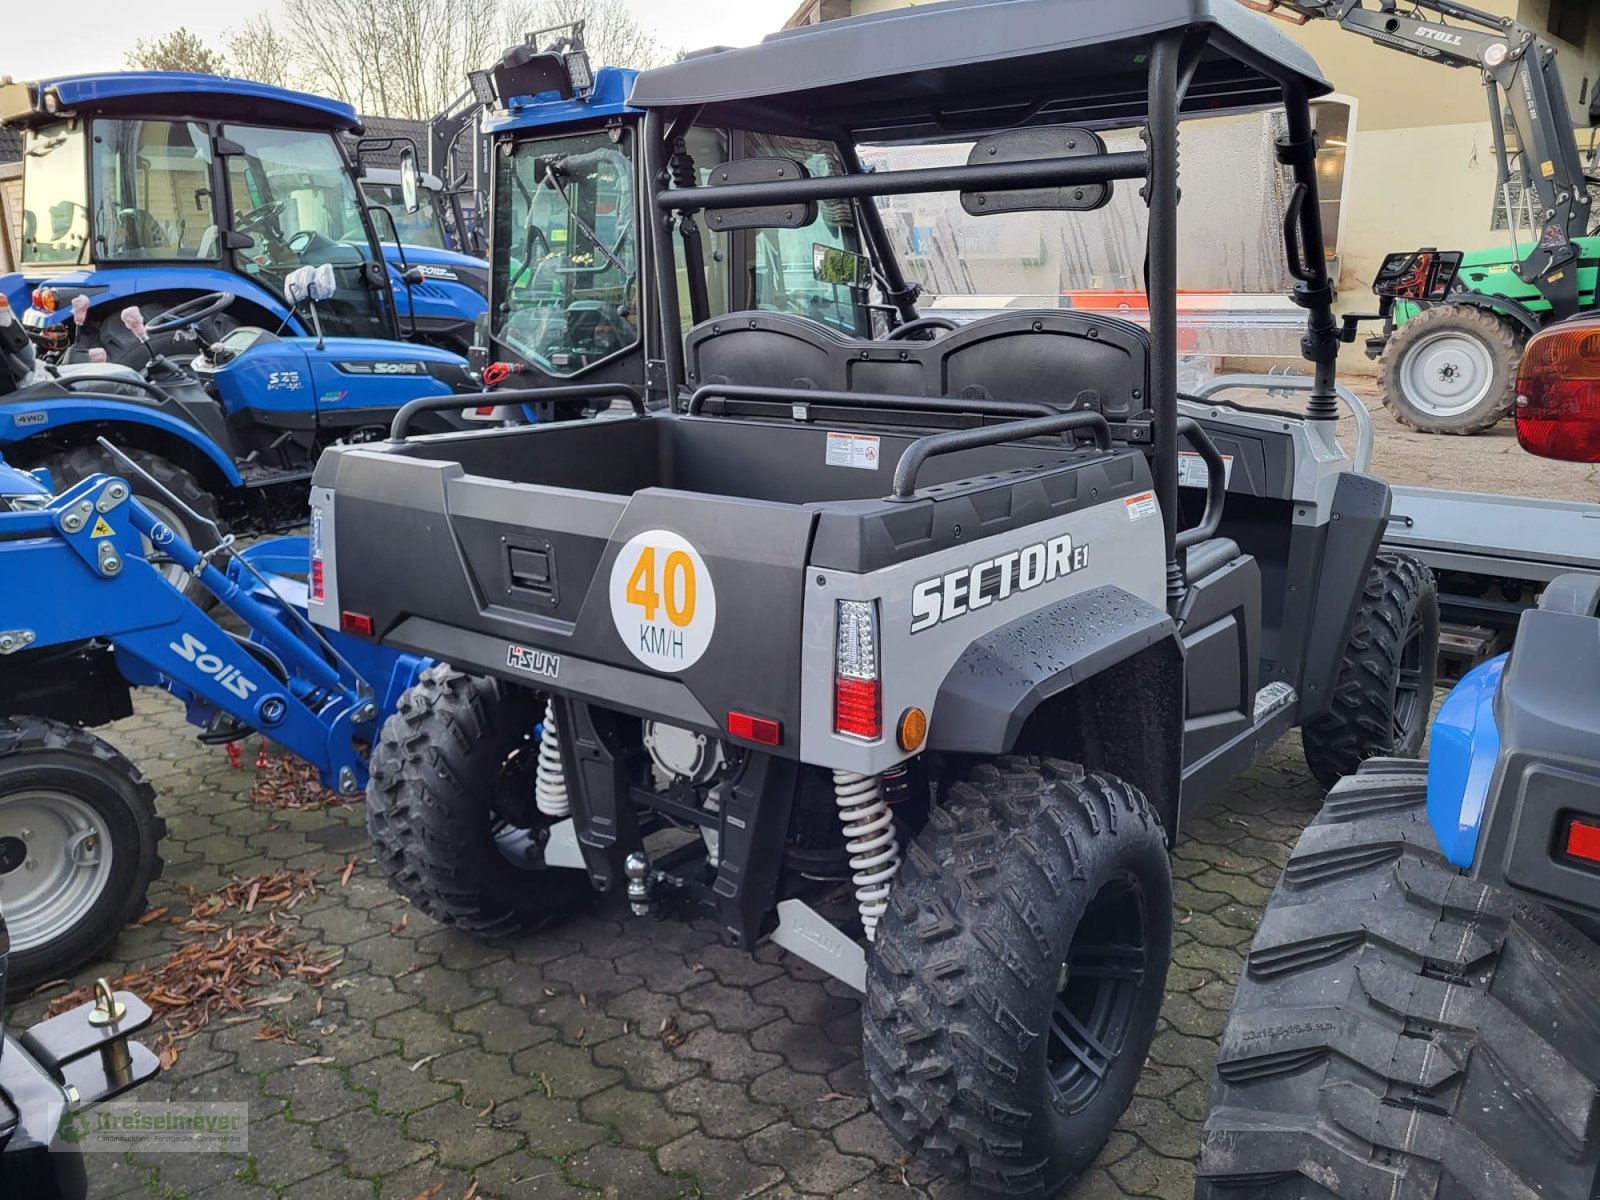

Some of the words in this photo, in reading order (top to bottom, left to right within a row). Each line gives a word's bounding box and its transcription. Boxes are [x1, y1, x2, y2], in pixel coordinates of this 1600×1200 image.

[1414, 26, 1464, 46] STOLL
[1527, 100, 1536, 109] CL
[18, 413, 45, 423] 4WD
[626, 546, 697, 627] 40
[910, 533, 1073, 635] SECTOR
[1072, 544, 1090, 571] E1
[639, 623, 684, 660] KM/H
[506, 644, 560, 678] HSUN
